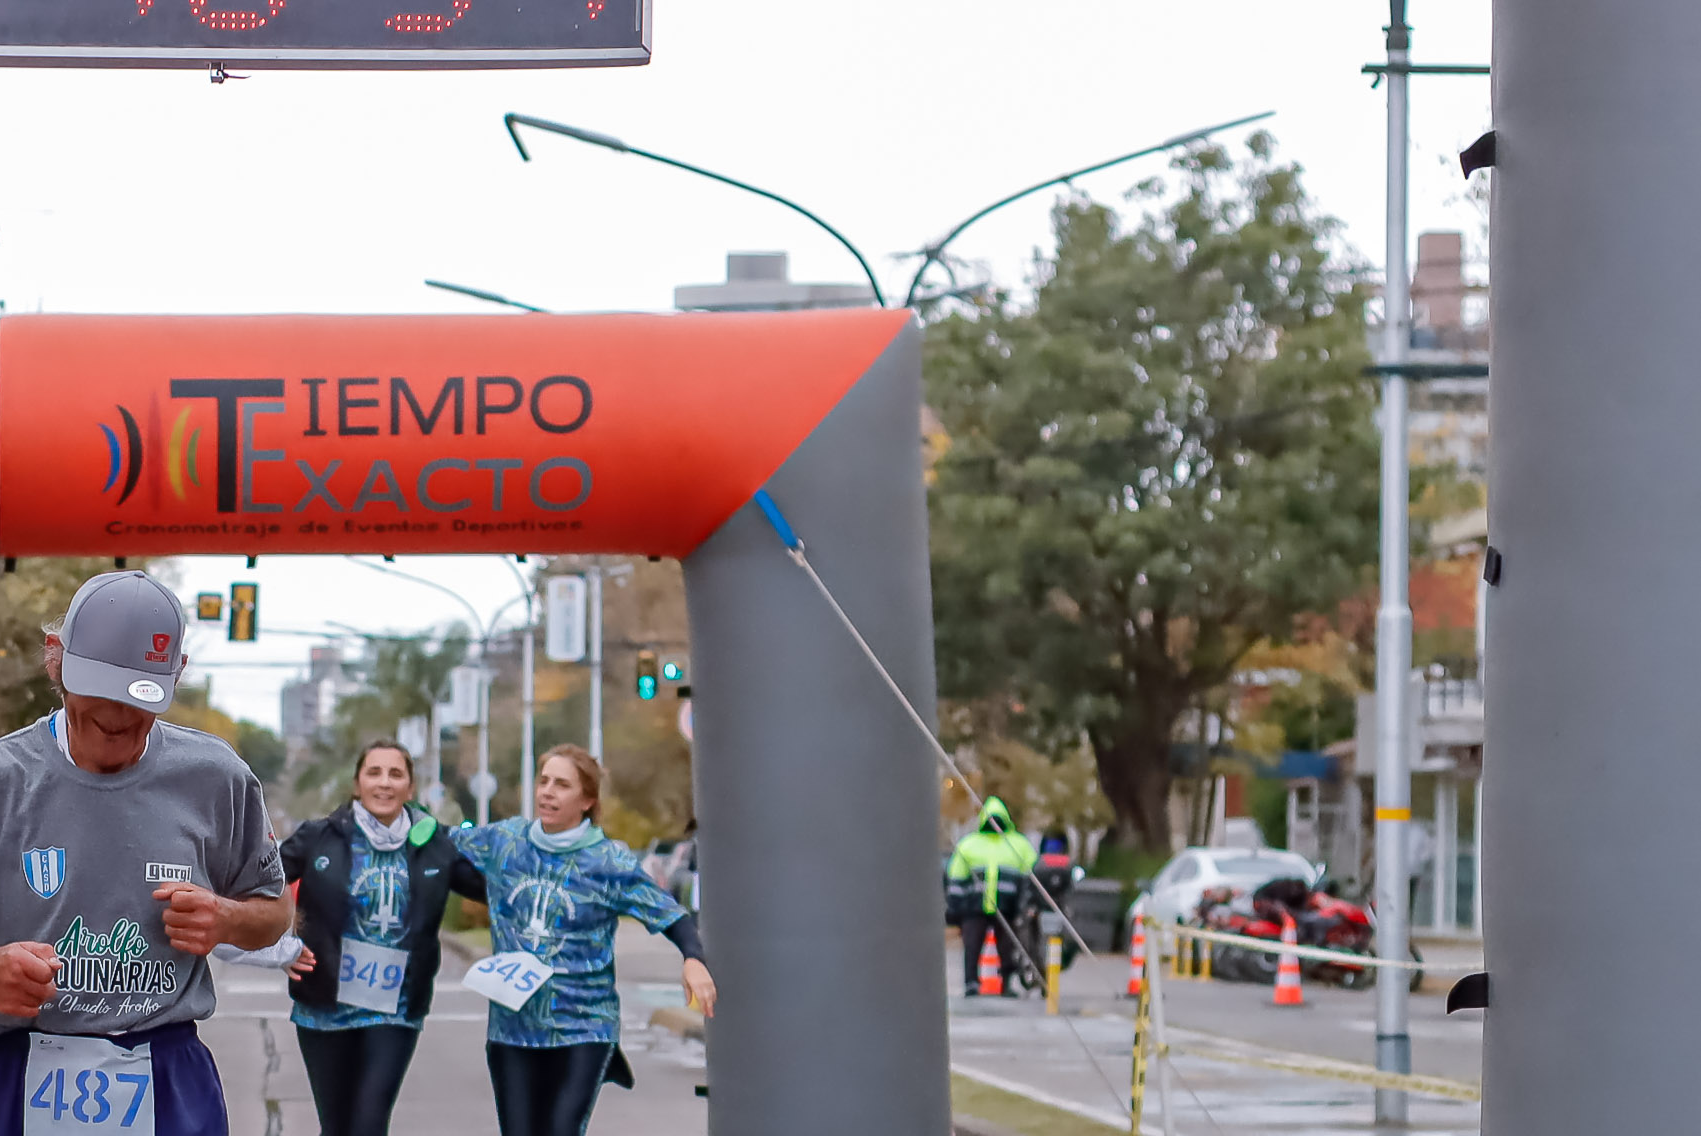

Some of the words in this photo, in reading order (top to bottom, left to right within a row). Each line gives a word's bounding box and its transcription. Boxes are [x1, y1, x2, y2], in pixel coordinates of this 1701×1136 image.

[170, 375, 593, 513] TIEMPO
[241, 402, 593, 513] EXACTO
[105, 520, 281, 537] Cronometraje
[298, 520, 329, 533] de
[344, 519, 439, 533] Eventos
[453, 518, 583, 534] Deportivos
[41, 854, 50, 892] CASD
[147, 864, 191, 882] giorgi
[54, 915, 149, 965] Arolfo
[53, 957, 177, 995] QUINARIAS
[339, 953, 404, 992] 349
[477, 958, 542, 993] 345
[58, 994, 112, 1014] Claudio
[116, 994, 162, 1017] Arolfo
[29, 1068, 150, 1128] 487
